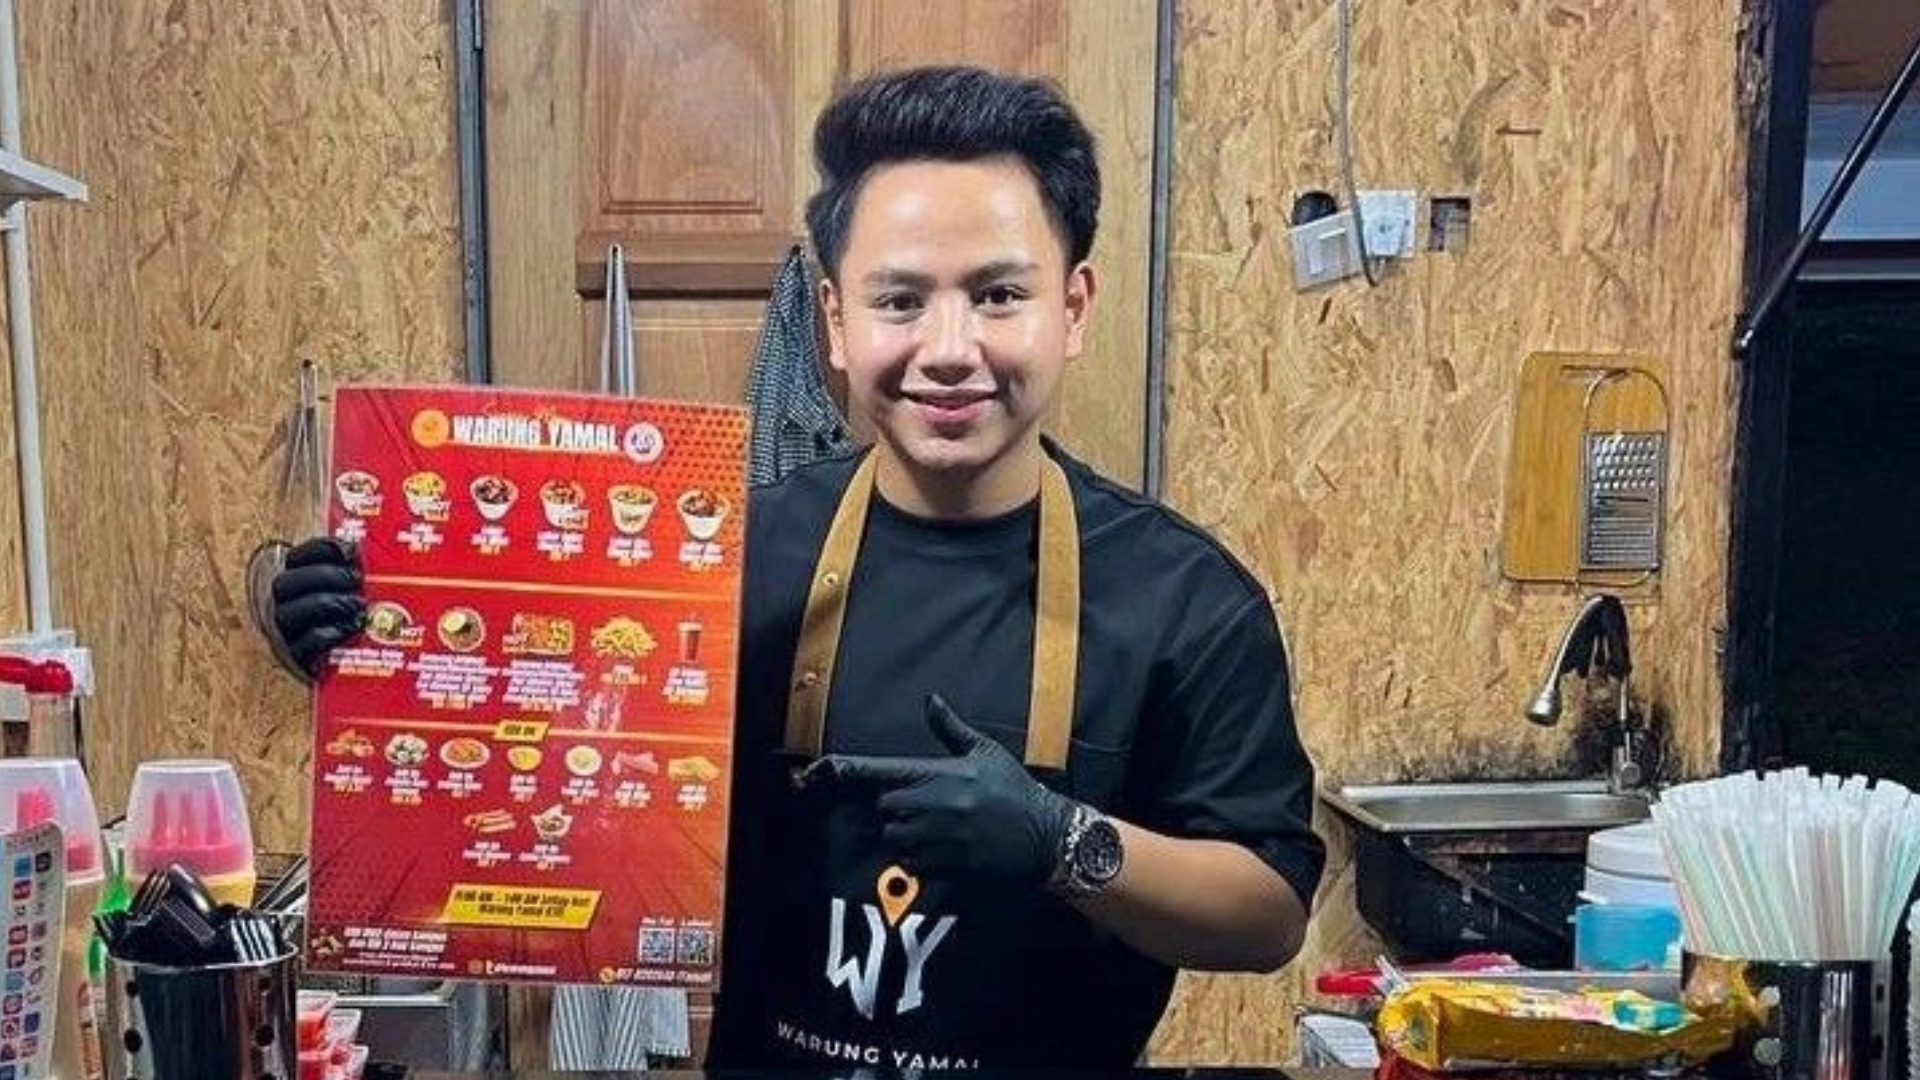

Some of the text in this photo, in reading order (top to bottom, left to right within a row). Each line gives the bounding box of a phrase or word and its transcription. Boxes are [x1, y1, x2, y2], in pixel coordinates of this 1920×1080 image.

[453, 415, 620, 452] WARUNG YAMAL
[777, 1021, 880, 1065] WARUNG
